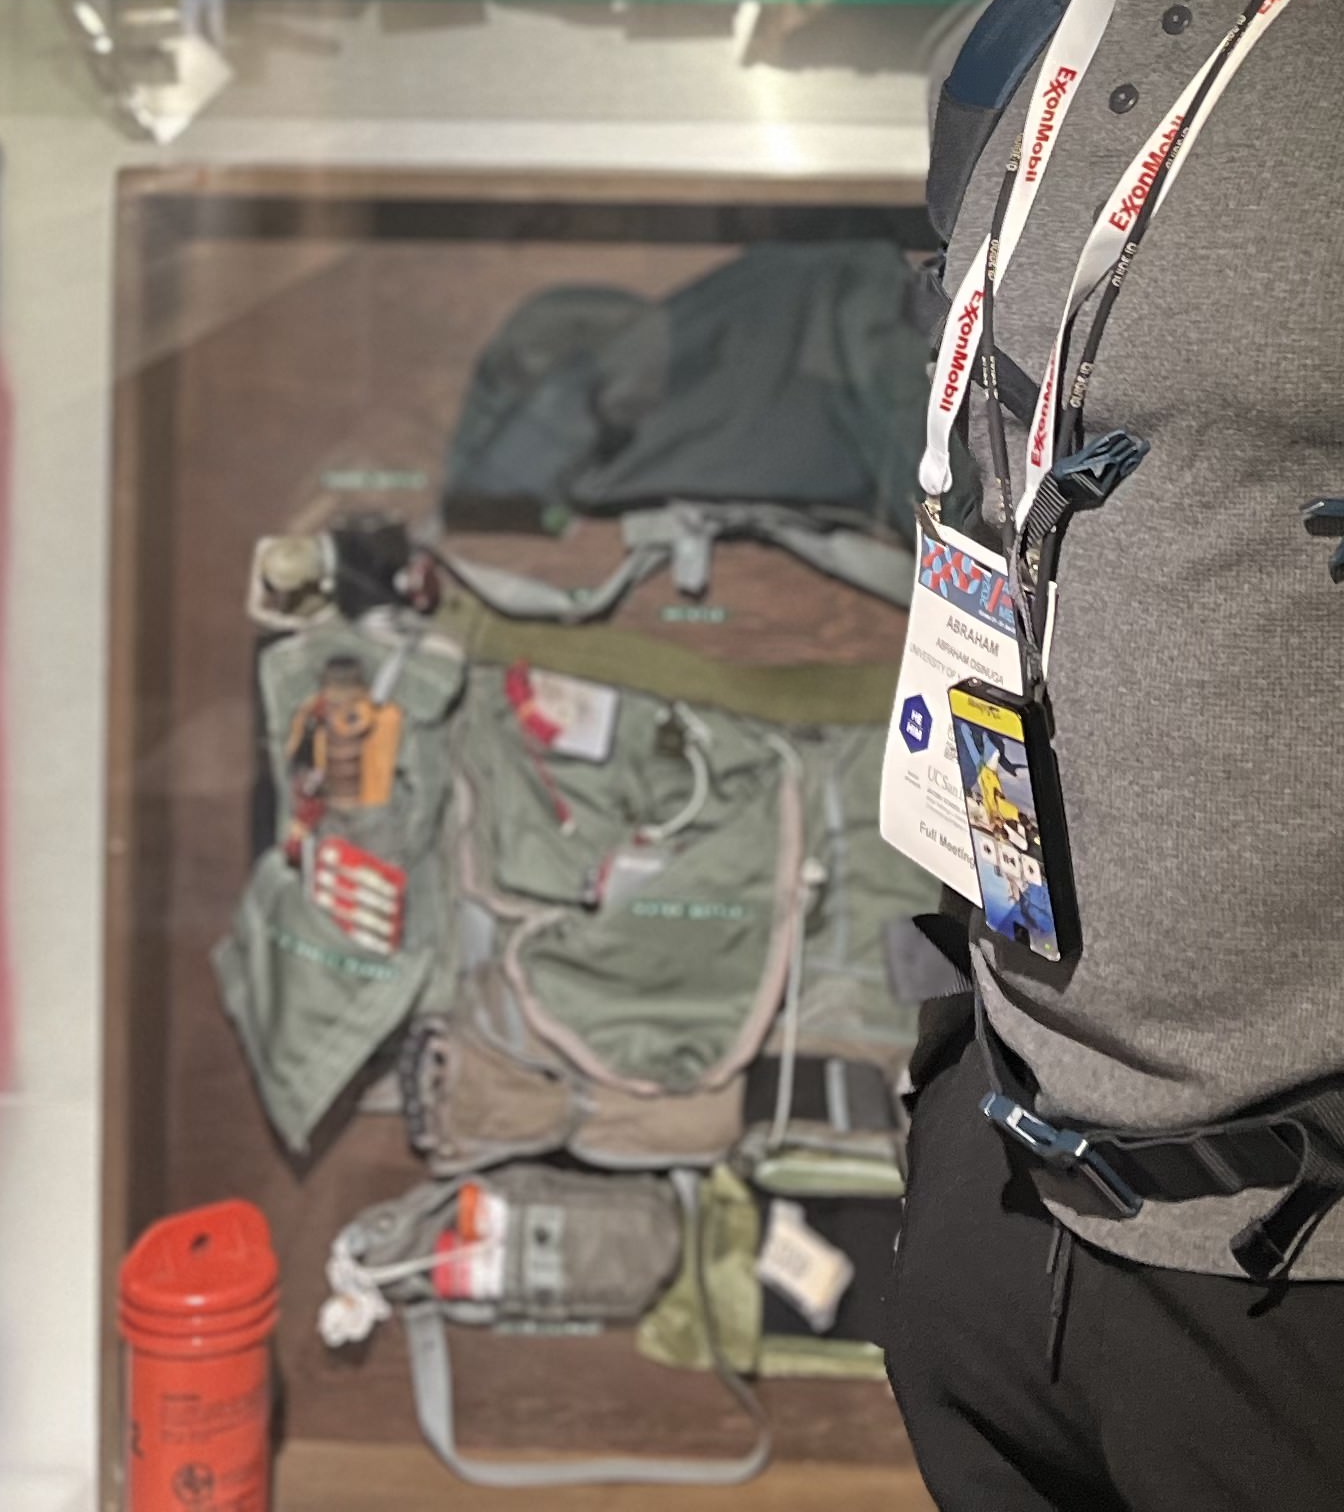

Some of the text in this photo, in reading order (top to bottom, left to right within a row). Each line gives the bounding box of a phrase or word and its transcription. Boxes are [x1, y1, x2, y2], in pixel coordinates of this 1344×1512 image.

[1025, 65, 1078, 183] ExxonMobil
[939, 288, 985, 413] ExxonMobil
[945, 614, 1000, 657] ABRAHAM
[919, 819, 976, 871] Full Meeting
